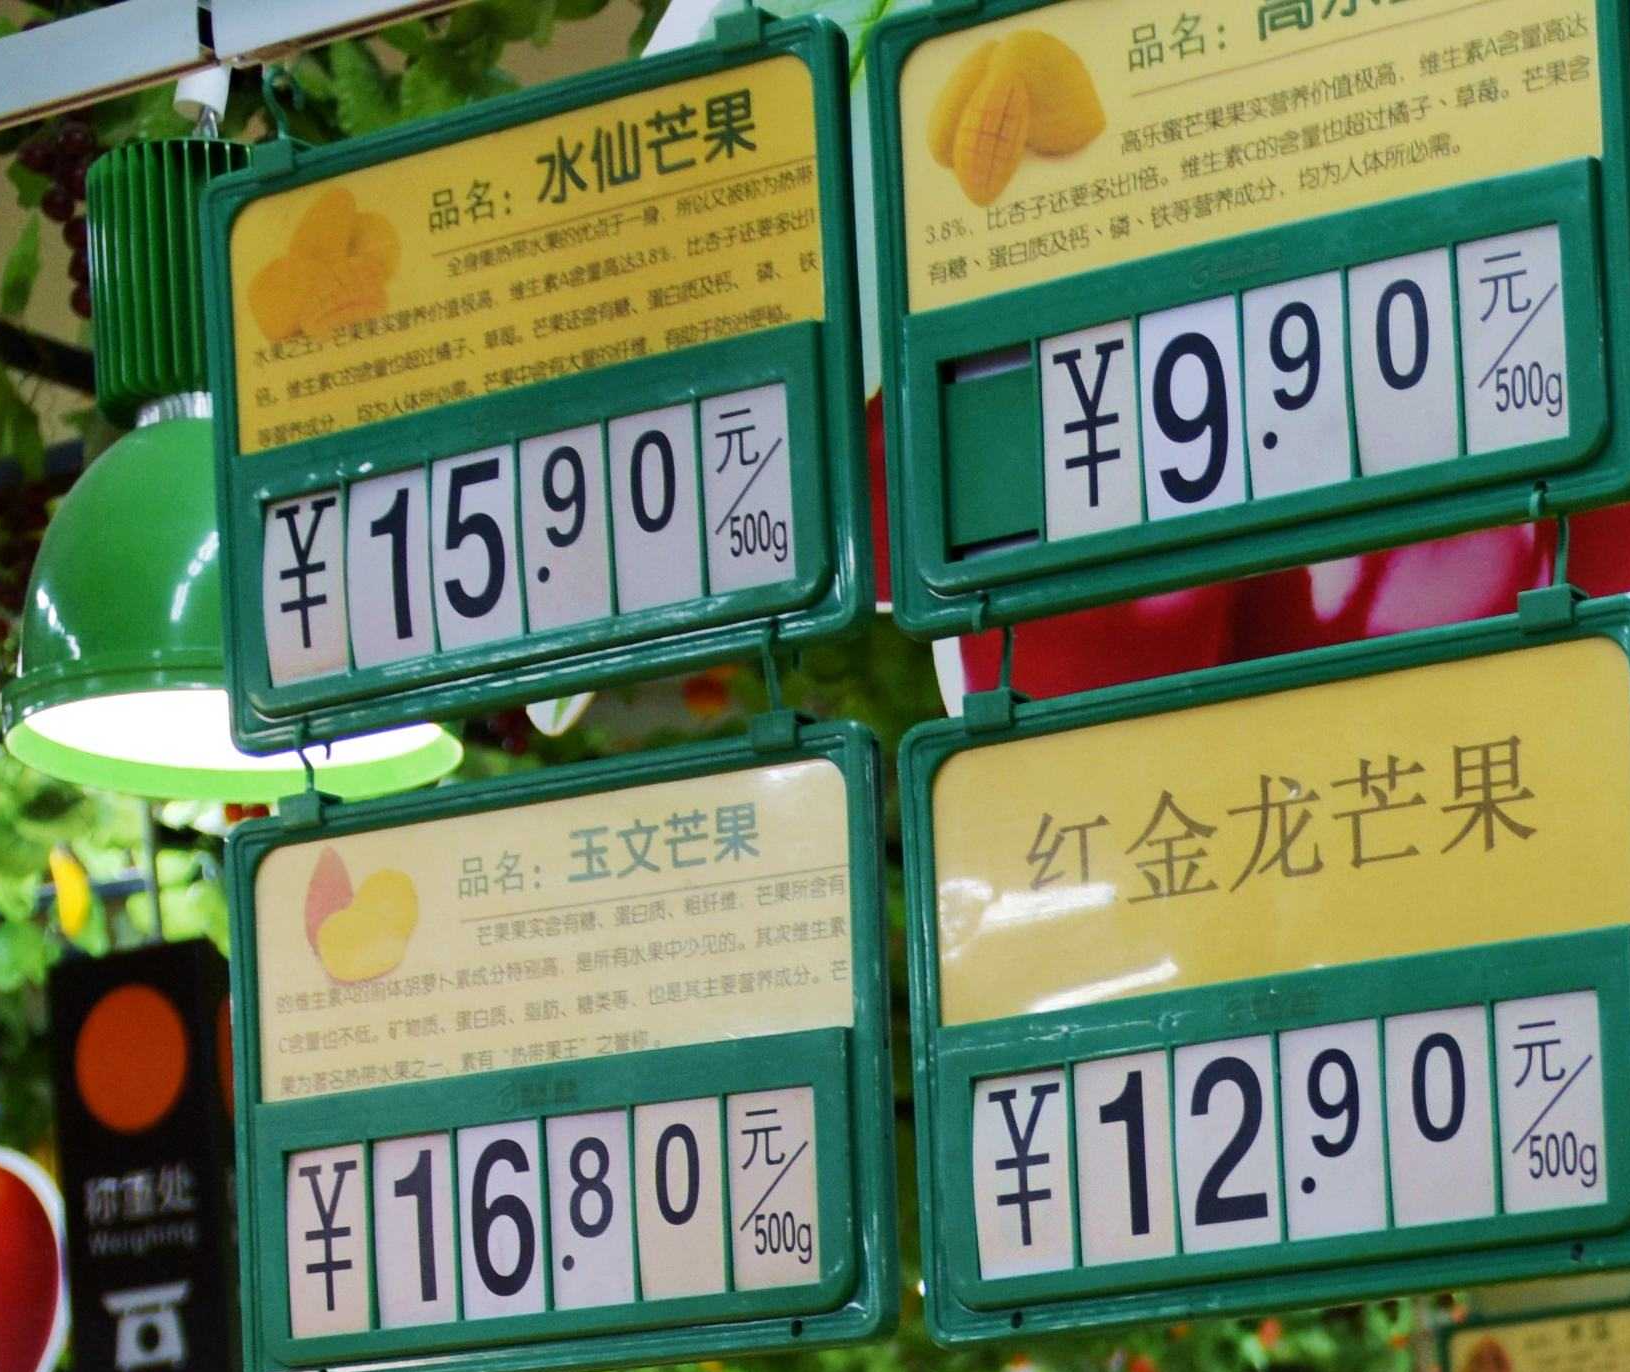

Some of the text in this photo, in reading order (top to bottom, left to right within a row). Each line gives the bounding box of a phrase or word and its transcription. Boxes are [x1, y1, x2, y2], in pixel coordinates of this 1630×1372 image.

[535, 87, 757, 206] 水仙芒果
[1053, 277, 1430, 508] ¥9.90
[275, 429, 677, 649] ¥15.90
[567, 801, 761, 883] 玉文芒果
[1023, 734, 1537, 906] 红金龙芒果
[299, 1121, 701, 1311] ¥16.80
[988, 1032, 1466, 1246] ¥12.90
